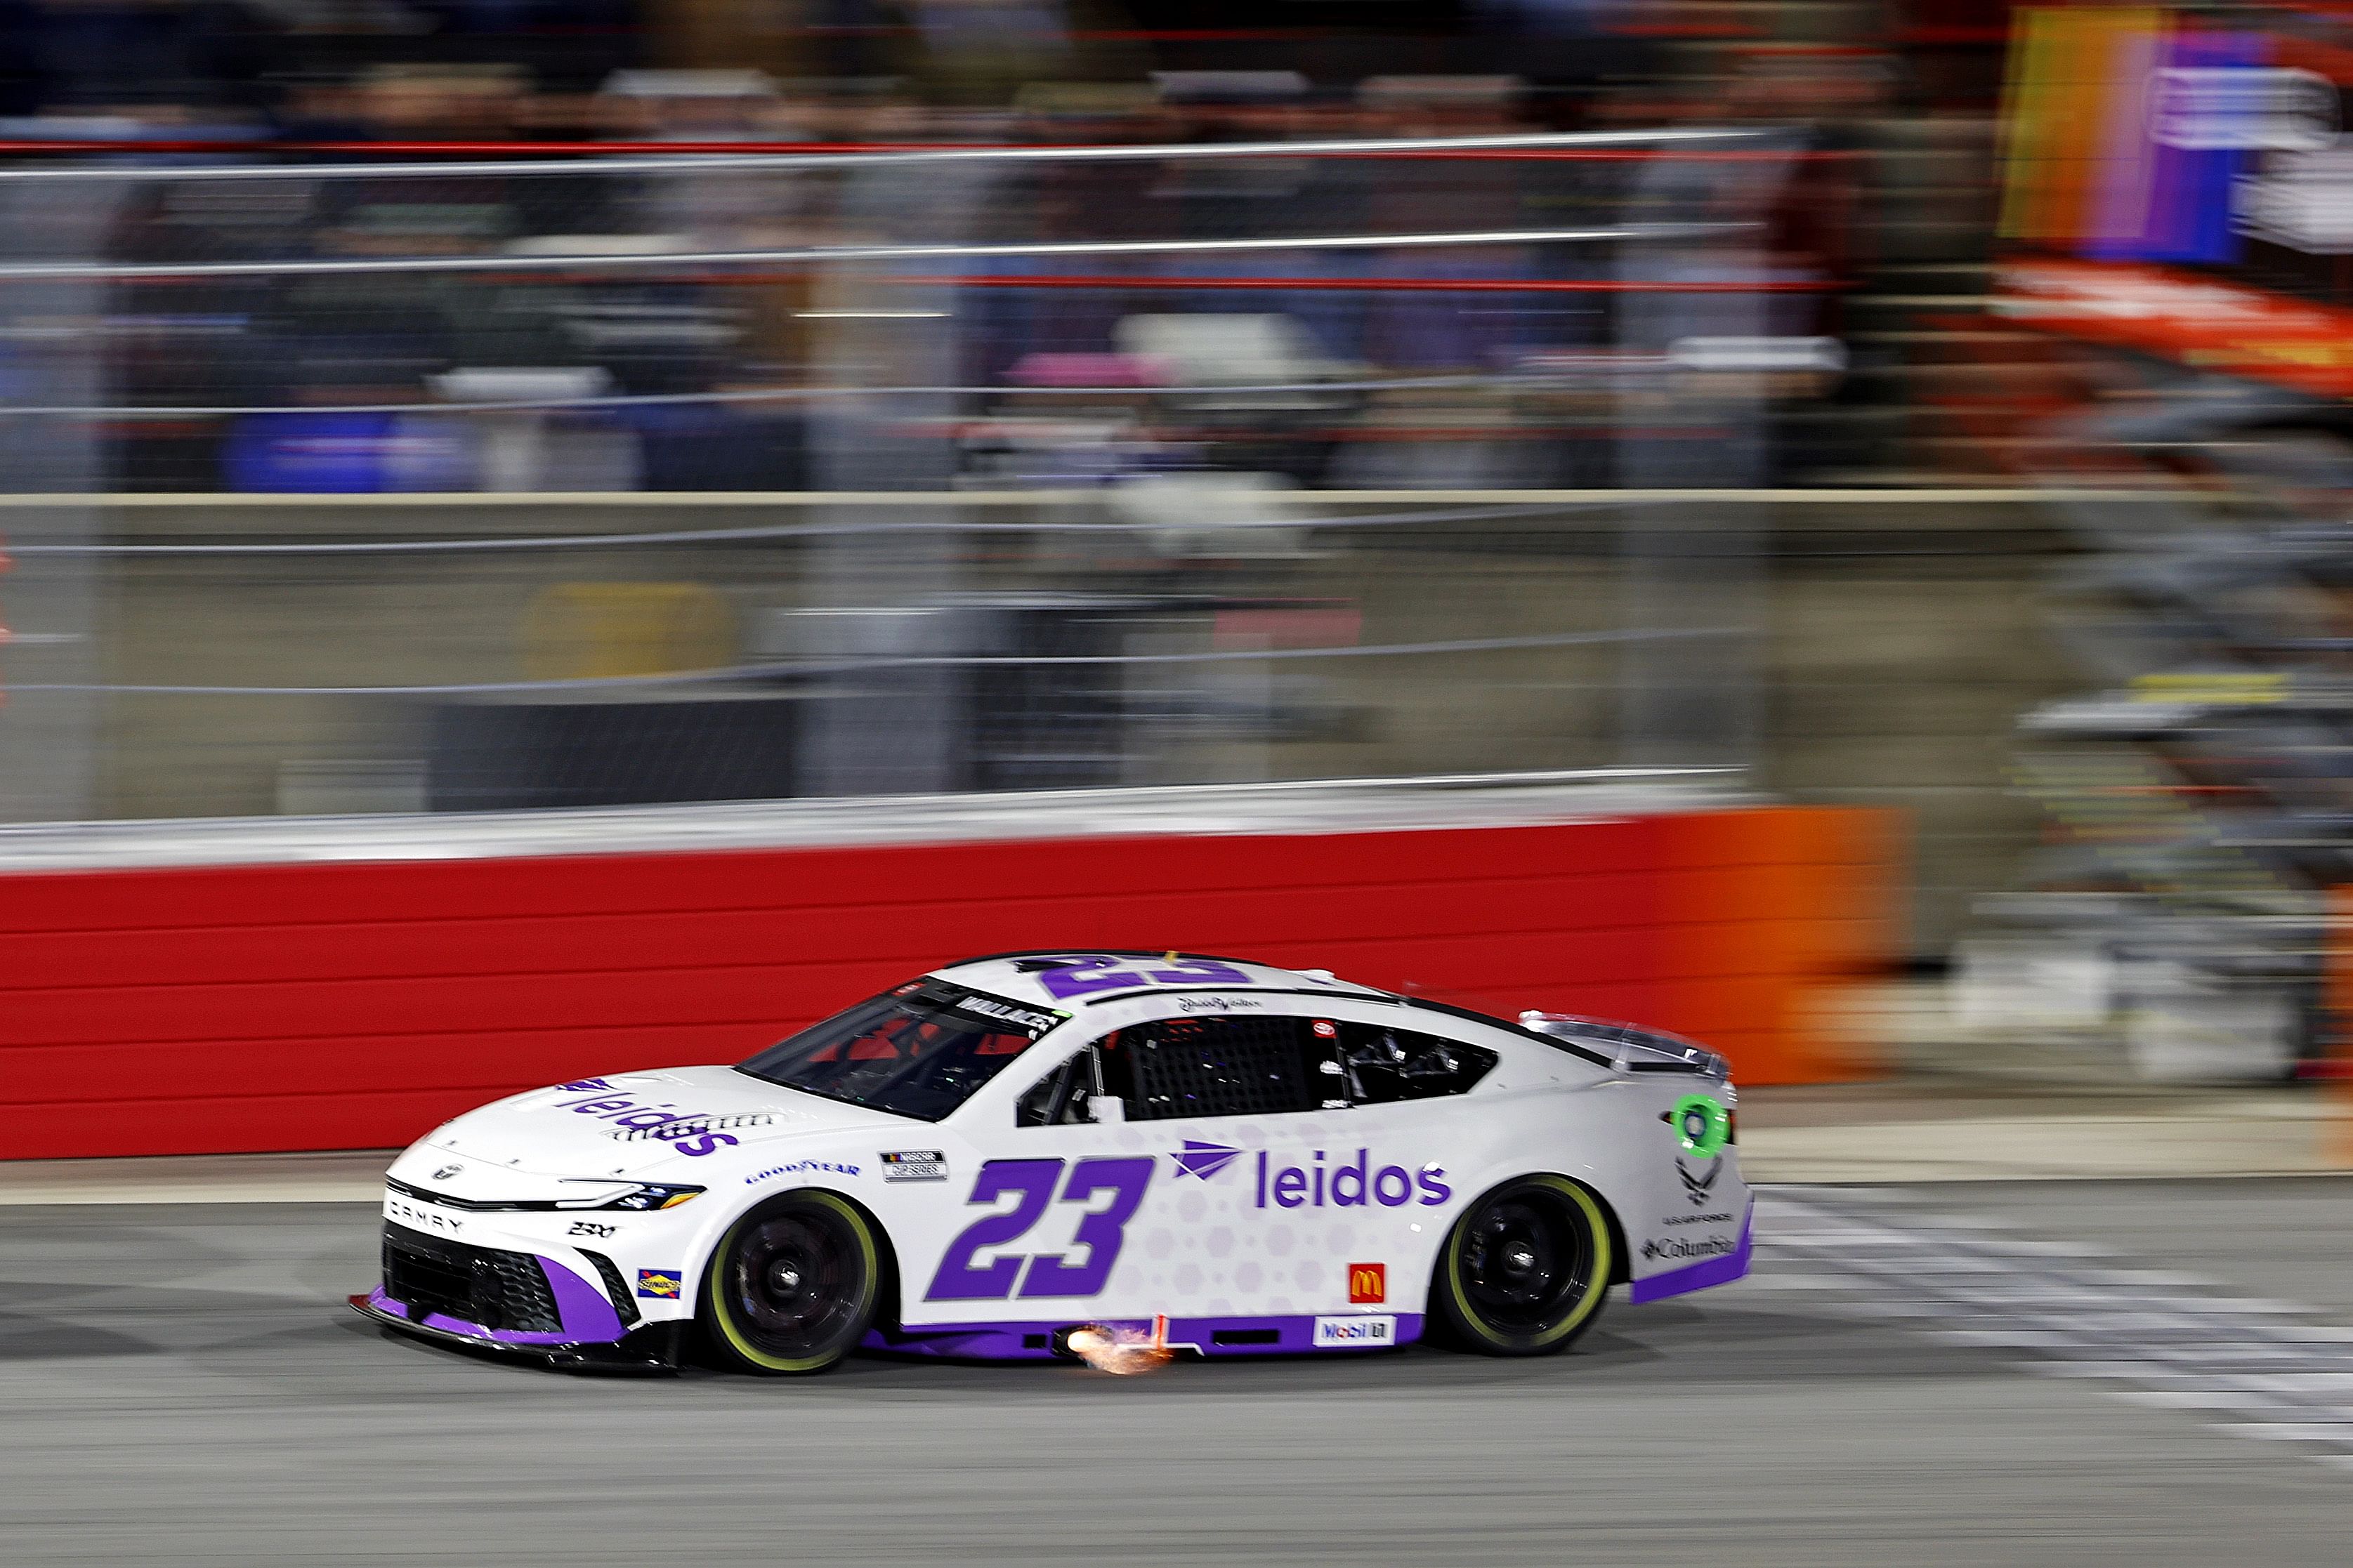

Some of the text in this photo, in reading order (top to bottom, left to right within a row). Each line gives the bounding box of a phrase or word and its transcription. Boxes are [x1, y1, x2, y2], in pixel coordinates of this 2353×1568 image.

[955, 996, 1058, 1032] WALLACE
[553, 1091, 740, 1157] leidos
[745, 1159, 861, 1185] GOODYEAR
[900, 1152, 936, 1162] NASCAR
[1256, 1148, 1452, 1208] leidos
[388, 1199, 462, 1234] CAMRY
[923, 1157, 1156, 1302] 23
